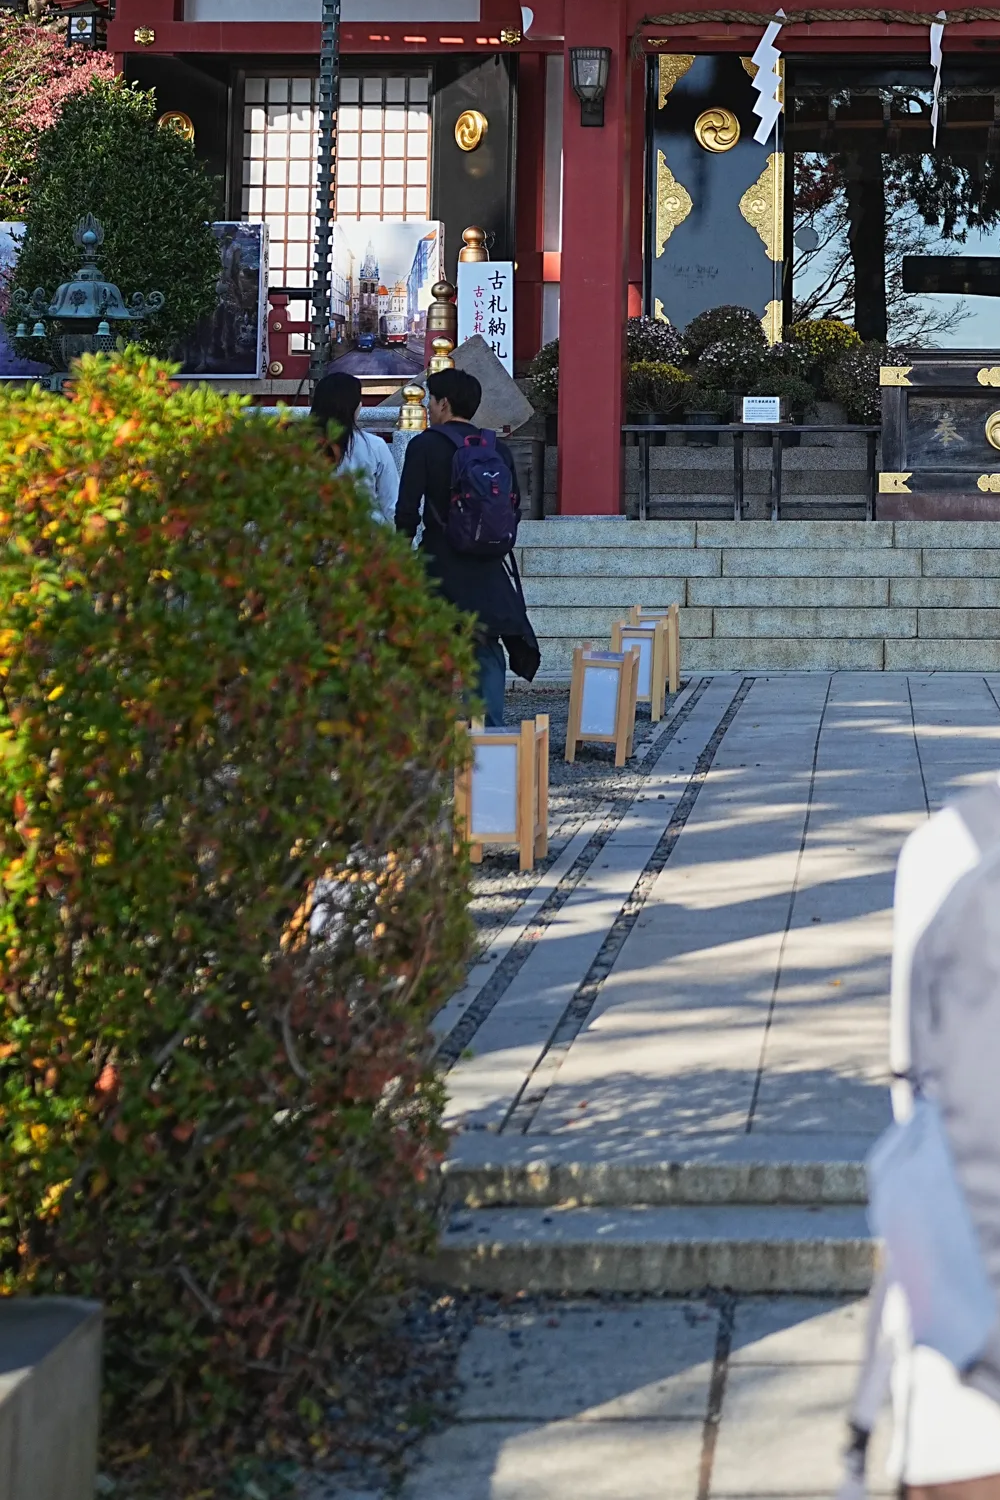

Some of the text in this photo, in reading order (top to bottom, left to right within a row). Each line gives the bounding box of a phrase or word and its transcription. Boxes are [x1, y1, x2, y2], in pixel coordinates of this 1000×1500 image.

[473, 285, 485, 333] 古いお札
[487, 270, 508, 359] 古札納札
